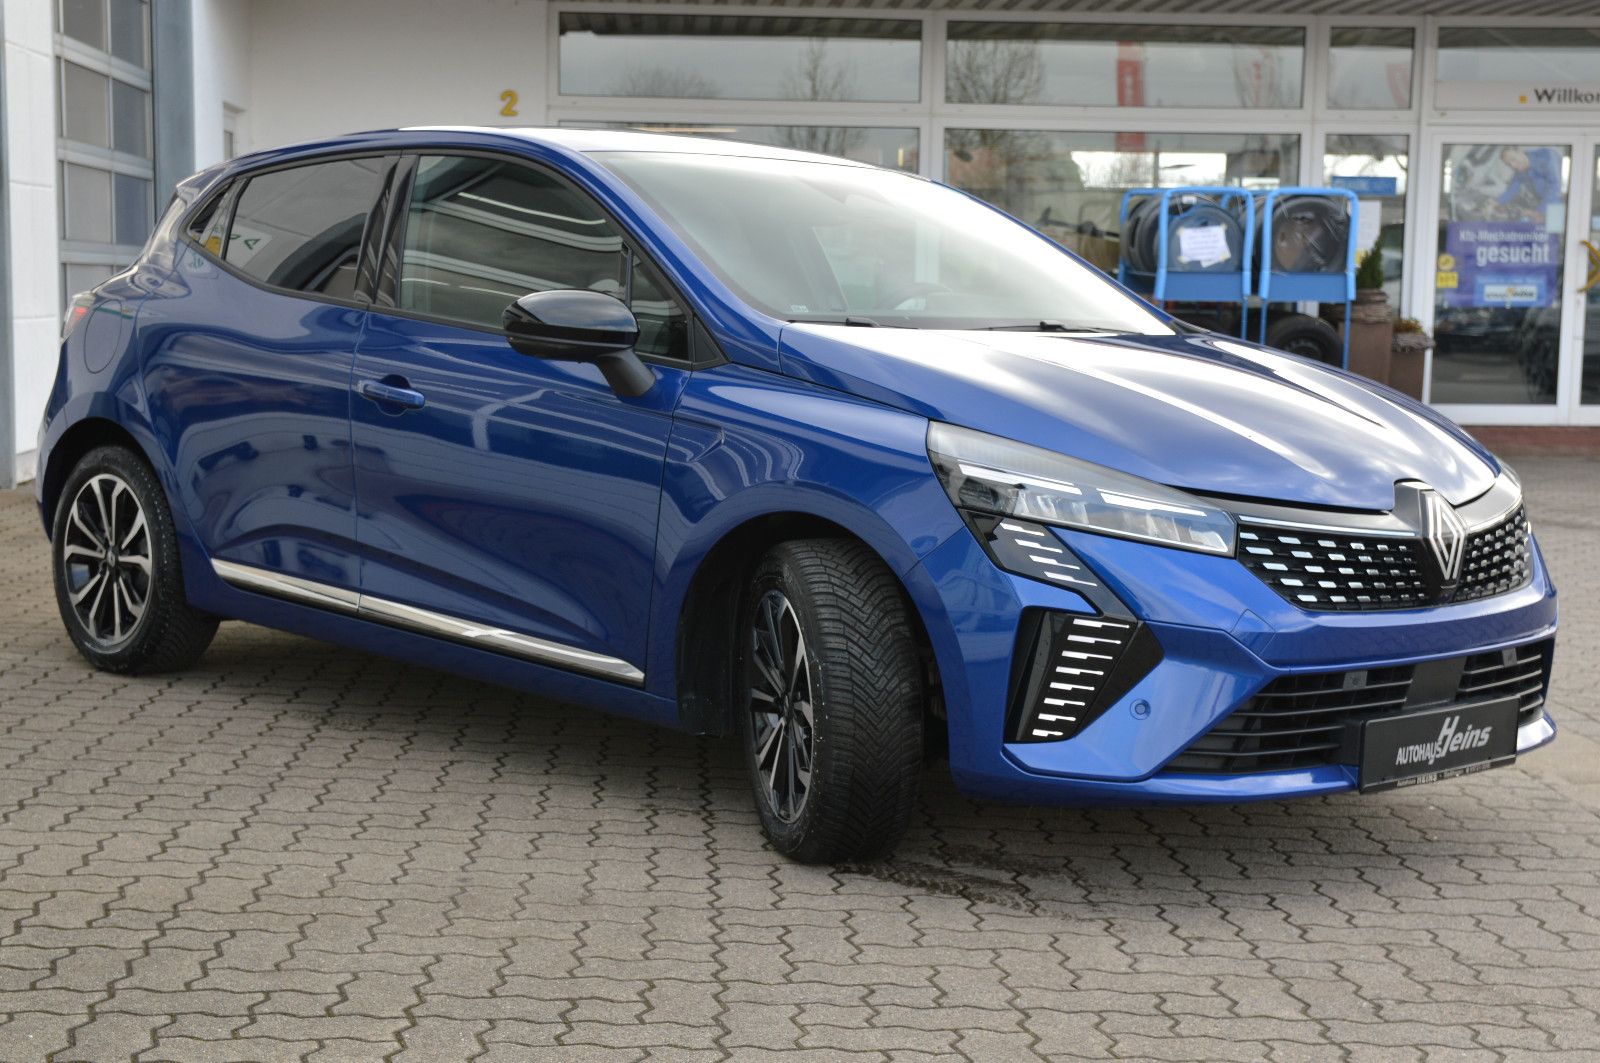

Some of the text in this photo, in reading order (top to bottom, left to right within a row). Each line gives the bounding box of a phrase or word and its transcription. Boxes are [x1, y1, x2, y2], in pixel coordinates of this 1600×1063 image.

[500, 90, 519, 117] 2
[1476, 243, 1550, 267] gesucht
[1438, 716, 1492, 757] Heins
